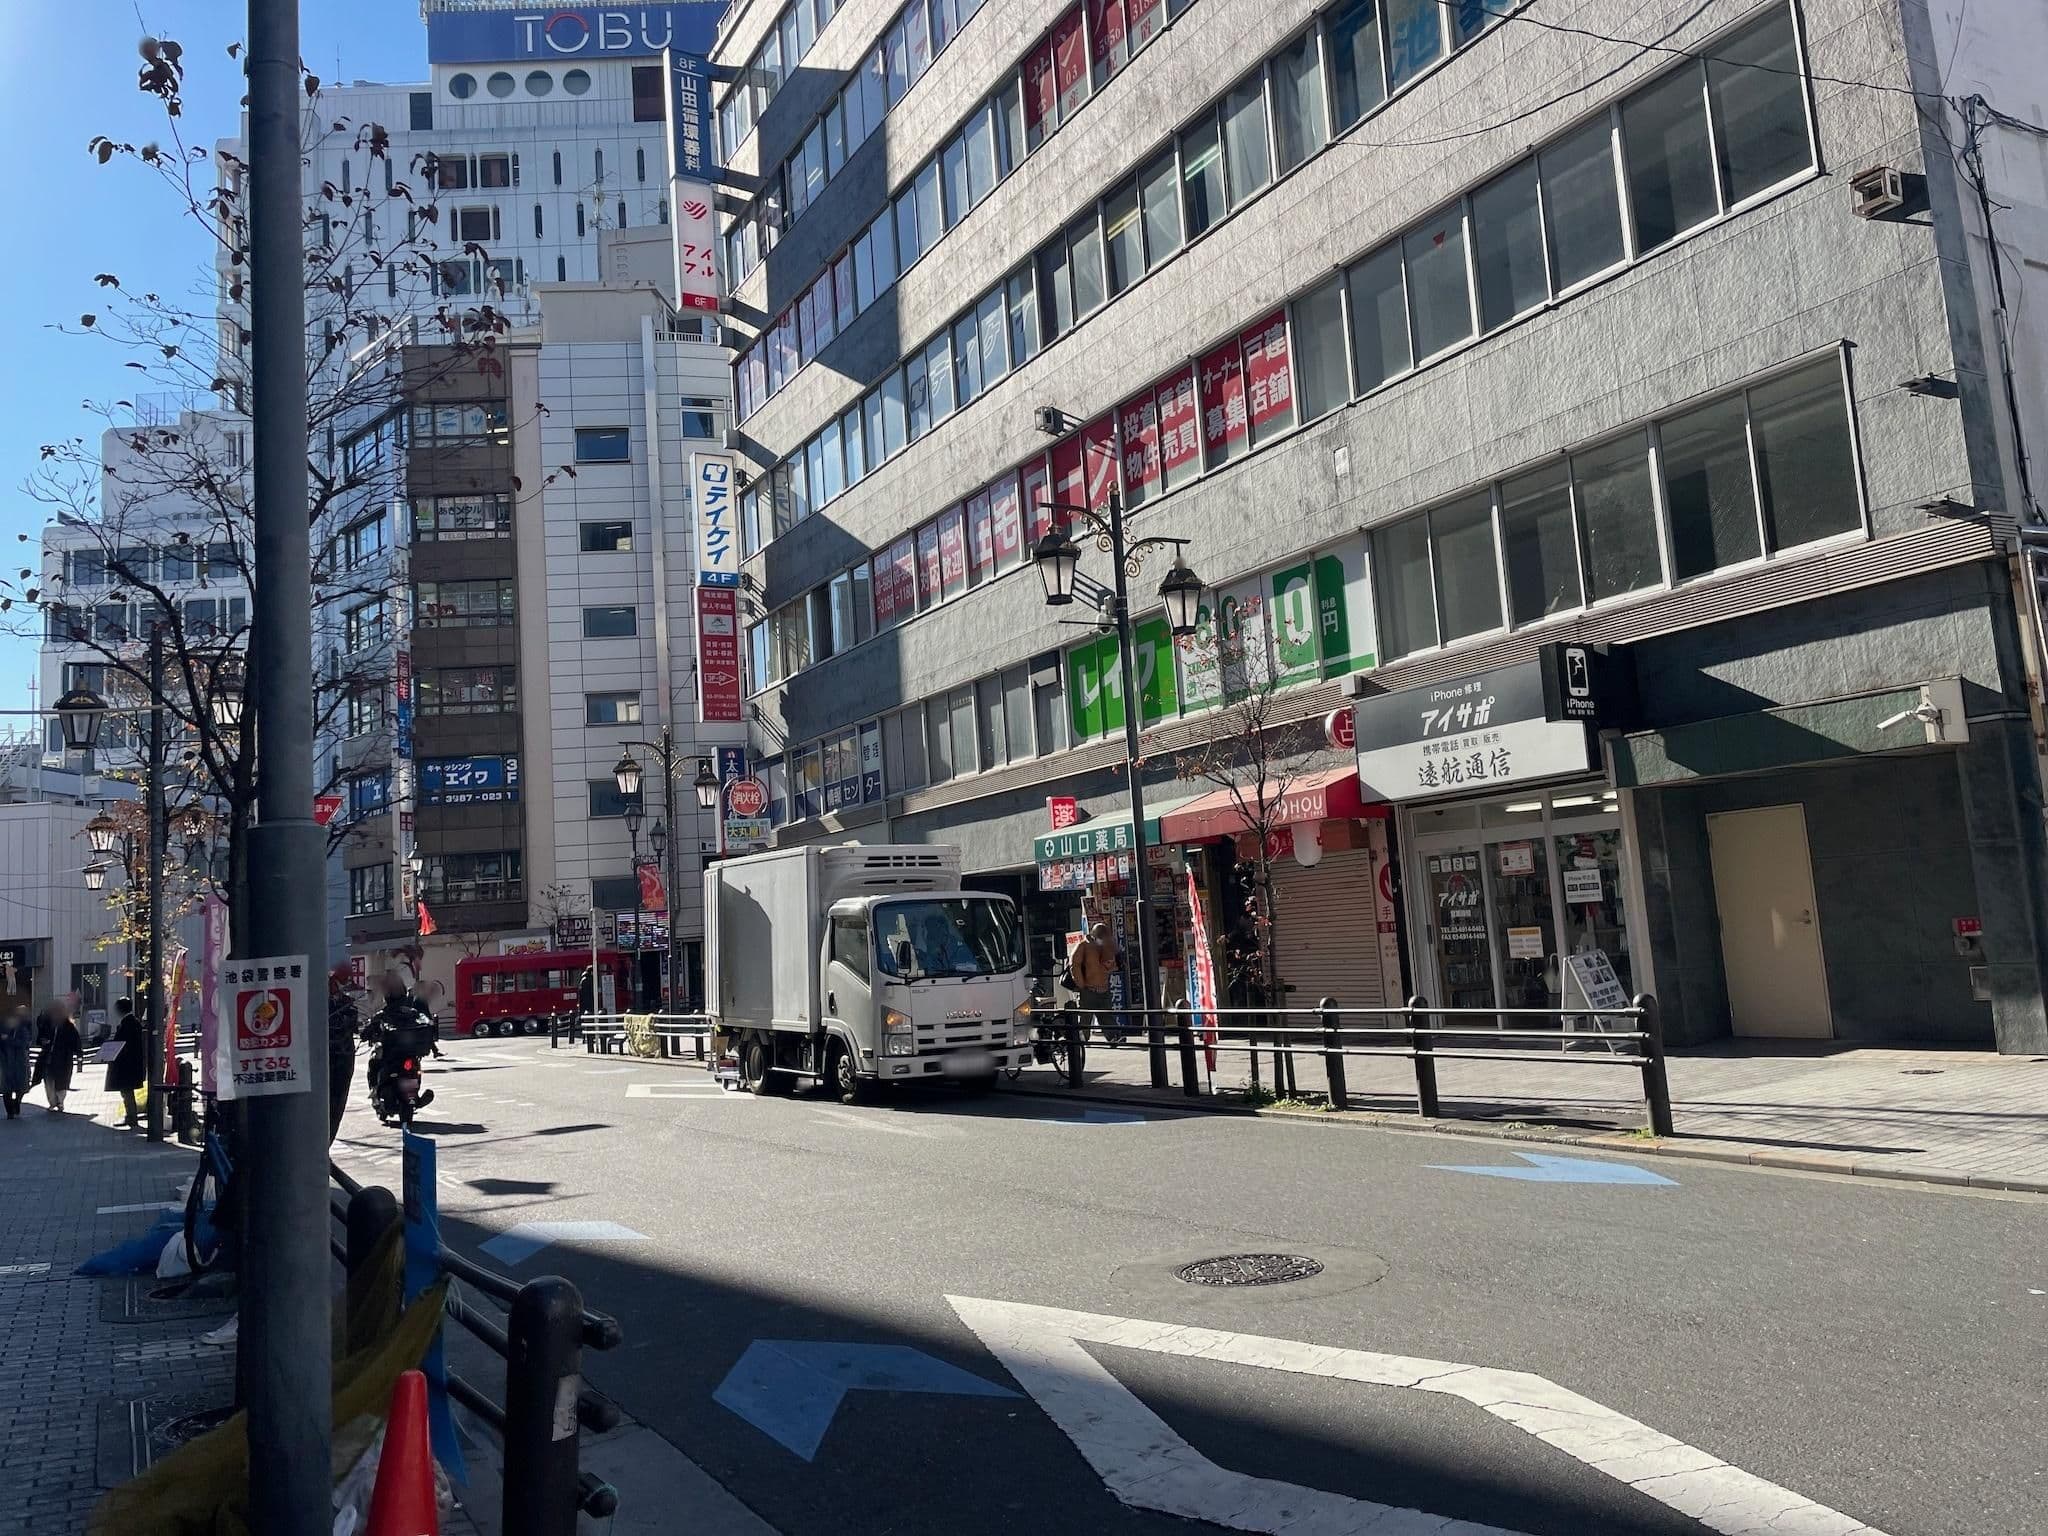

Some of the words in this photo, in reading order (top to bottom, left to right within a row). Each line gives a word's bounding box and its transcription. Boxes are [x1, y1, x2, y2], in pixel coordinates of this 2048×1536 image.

[514, 11, 673, 53] TOBU
[679, 57, 697, 70] 8F
[694, 296, 707, 306] 6F
[1242, 322, 1287, 373] 戸建
[1203, 356, 1242, 394] オーナー
[1157, 378, 1193, 424] 賃貸
[1248, 366, 1290, 417] 店舗
[1123, 401, 1156, 444] 投資
[1205, 393, 1246, 441] 募集
[1162, 419, 1198, 463] 売買
[1126, 443, 1159, 482] 物件
[707, 573, 733, 584] 4F
[1430, 686, 1463, 703] iPhone
[1464, 681, 1483, 693] 修理
[1566, 698, 1595, 709] iPhone
[1420, 695, 1496, 737] アイサポ
[1423, 738, 1460, 756] 携帯電話
[1462, 735, 1479, 749] 買取
[445, 770, 489, 786] エイワ
[733, 791, 761, 805] 消火栓
[1060, 826, 1127, 856] 山口薬局
[1438, 889, 1480, 907] アイサポ
[225, 964, 302, 985] 池袋警察署
[946, 1009, 983, 1019] ISUZU
[239, 1056, 291, 1072] すてるな
